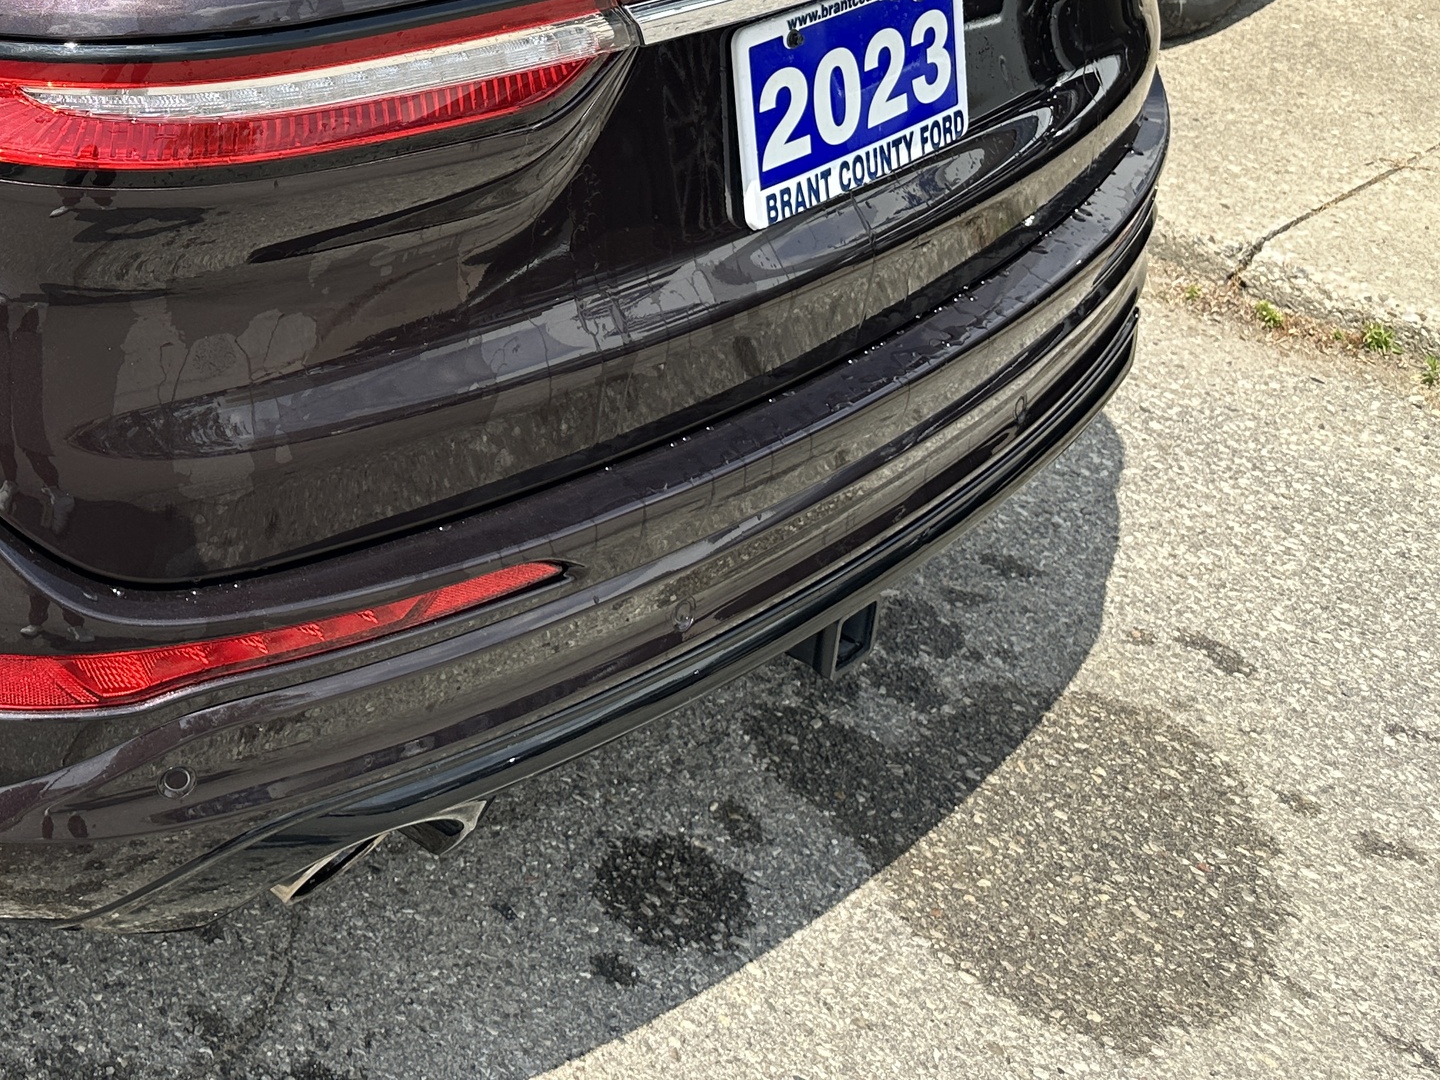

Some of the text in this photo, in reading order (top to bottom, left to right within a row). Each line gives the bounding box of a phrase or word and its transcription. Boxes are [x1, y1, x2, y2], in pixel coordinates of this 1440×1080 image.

[759, 9, 952, 172] 2023
[765, 109, 965, 224] BRANT COUNTY FORD
